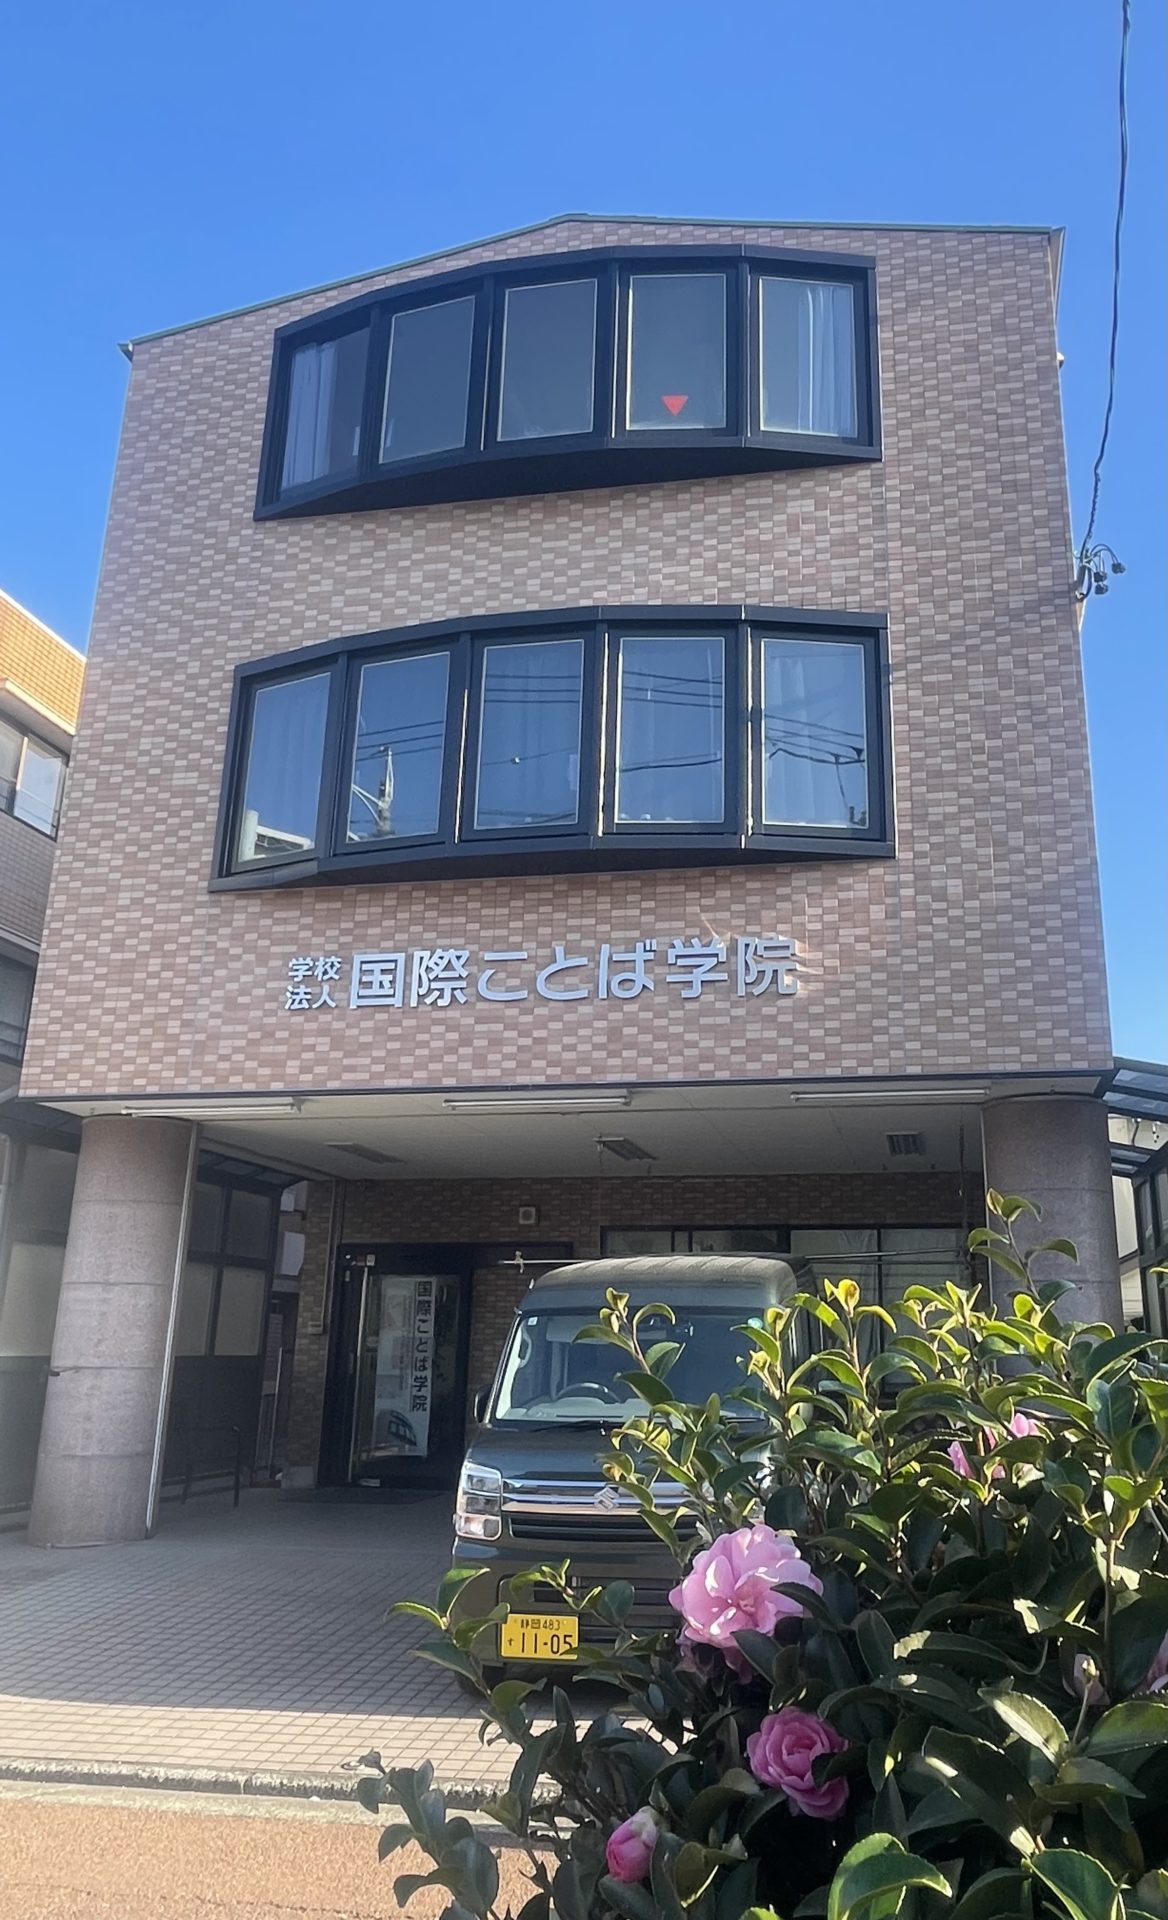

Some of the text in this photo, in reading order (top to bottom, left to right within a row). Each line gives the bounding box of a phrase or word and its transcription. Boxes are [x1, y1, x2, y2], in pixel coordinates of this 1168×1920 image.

[288, 955, 342, 982] 学校
[349, 935, 798, 1009] 国際ことば学院
[284, 984, 337, 1010] 法人
[412, 1280, 433, 1412] 国際ことば学院
